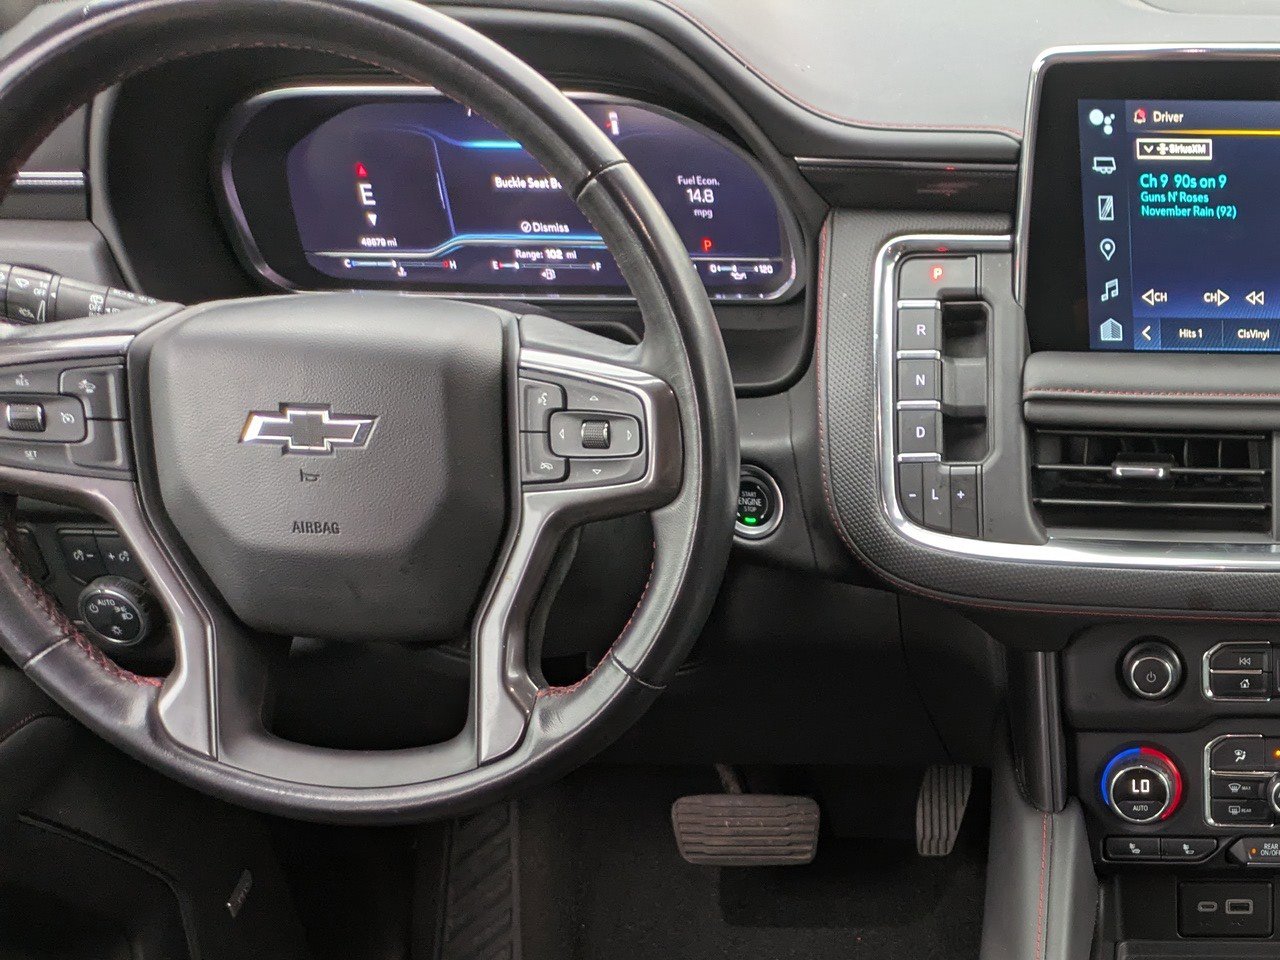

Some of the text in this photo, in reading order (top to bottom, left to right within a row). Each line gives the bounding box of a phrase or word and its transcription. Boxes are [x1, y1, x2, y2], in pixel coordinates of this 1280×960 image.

[1152, 110, 1184, 123] Driver
[1168, 143, 1207, 155] SiriusXM
[494, 176, 527, 188] Buckle
[527, 177, 549, 189] Seat
[677, 175, 720, 186] Fuel Econ.
[1139, 173, 1227, 189] Ch 9 90s on 9
[359, 183, 377, 206] E
[686, 188, 715, 204] 14.8
[1140, 191, 1166, 203] Guns
[1180, 191, 1209, 203] Roses
[693, 208, 713, 219] mpg
[1141, 205, 1237, 219] November Rain (92)
[532, 221, 570, 233] Dismiss
[703, 239, 713, 251] P
[514, 249, 544, 261] Range:
[565, 250, 577, 259] mi
[932, 267, 943, 280] P
[1153, 292, 1168, 303] CH
[1203, 292, 1217, 303] CH
[915, 324, 926, 336] R
[1179, 328, 1197, 339] Hits
[1237, 328, 1270, 341] ClsVinyl
[915, 374, 926, 386] N
[915, 426, 926, 438] D
[931, 488, 939, 499] L
[738, 497, 762, 507] ENGINE
[292, 520, 340, 535] AIRBAG
[97, 599, 116, 607] AUTO
[1131, 779, 1150, 794] LO
[1132, 804, 1149, 812] AUTO
